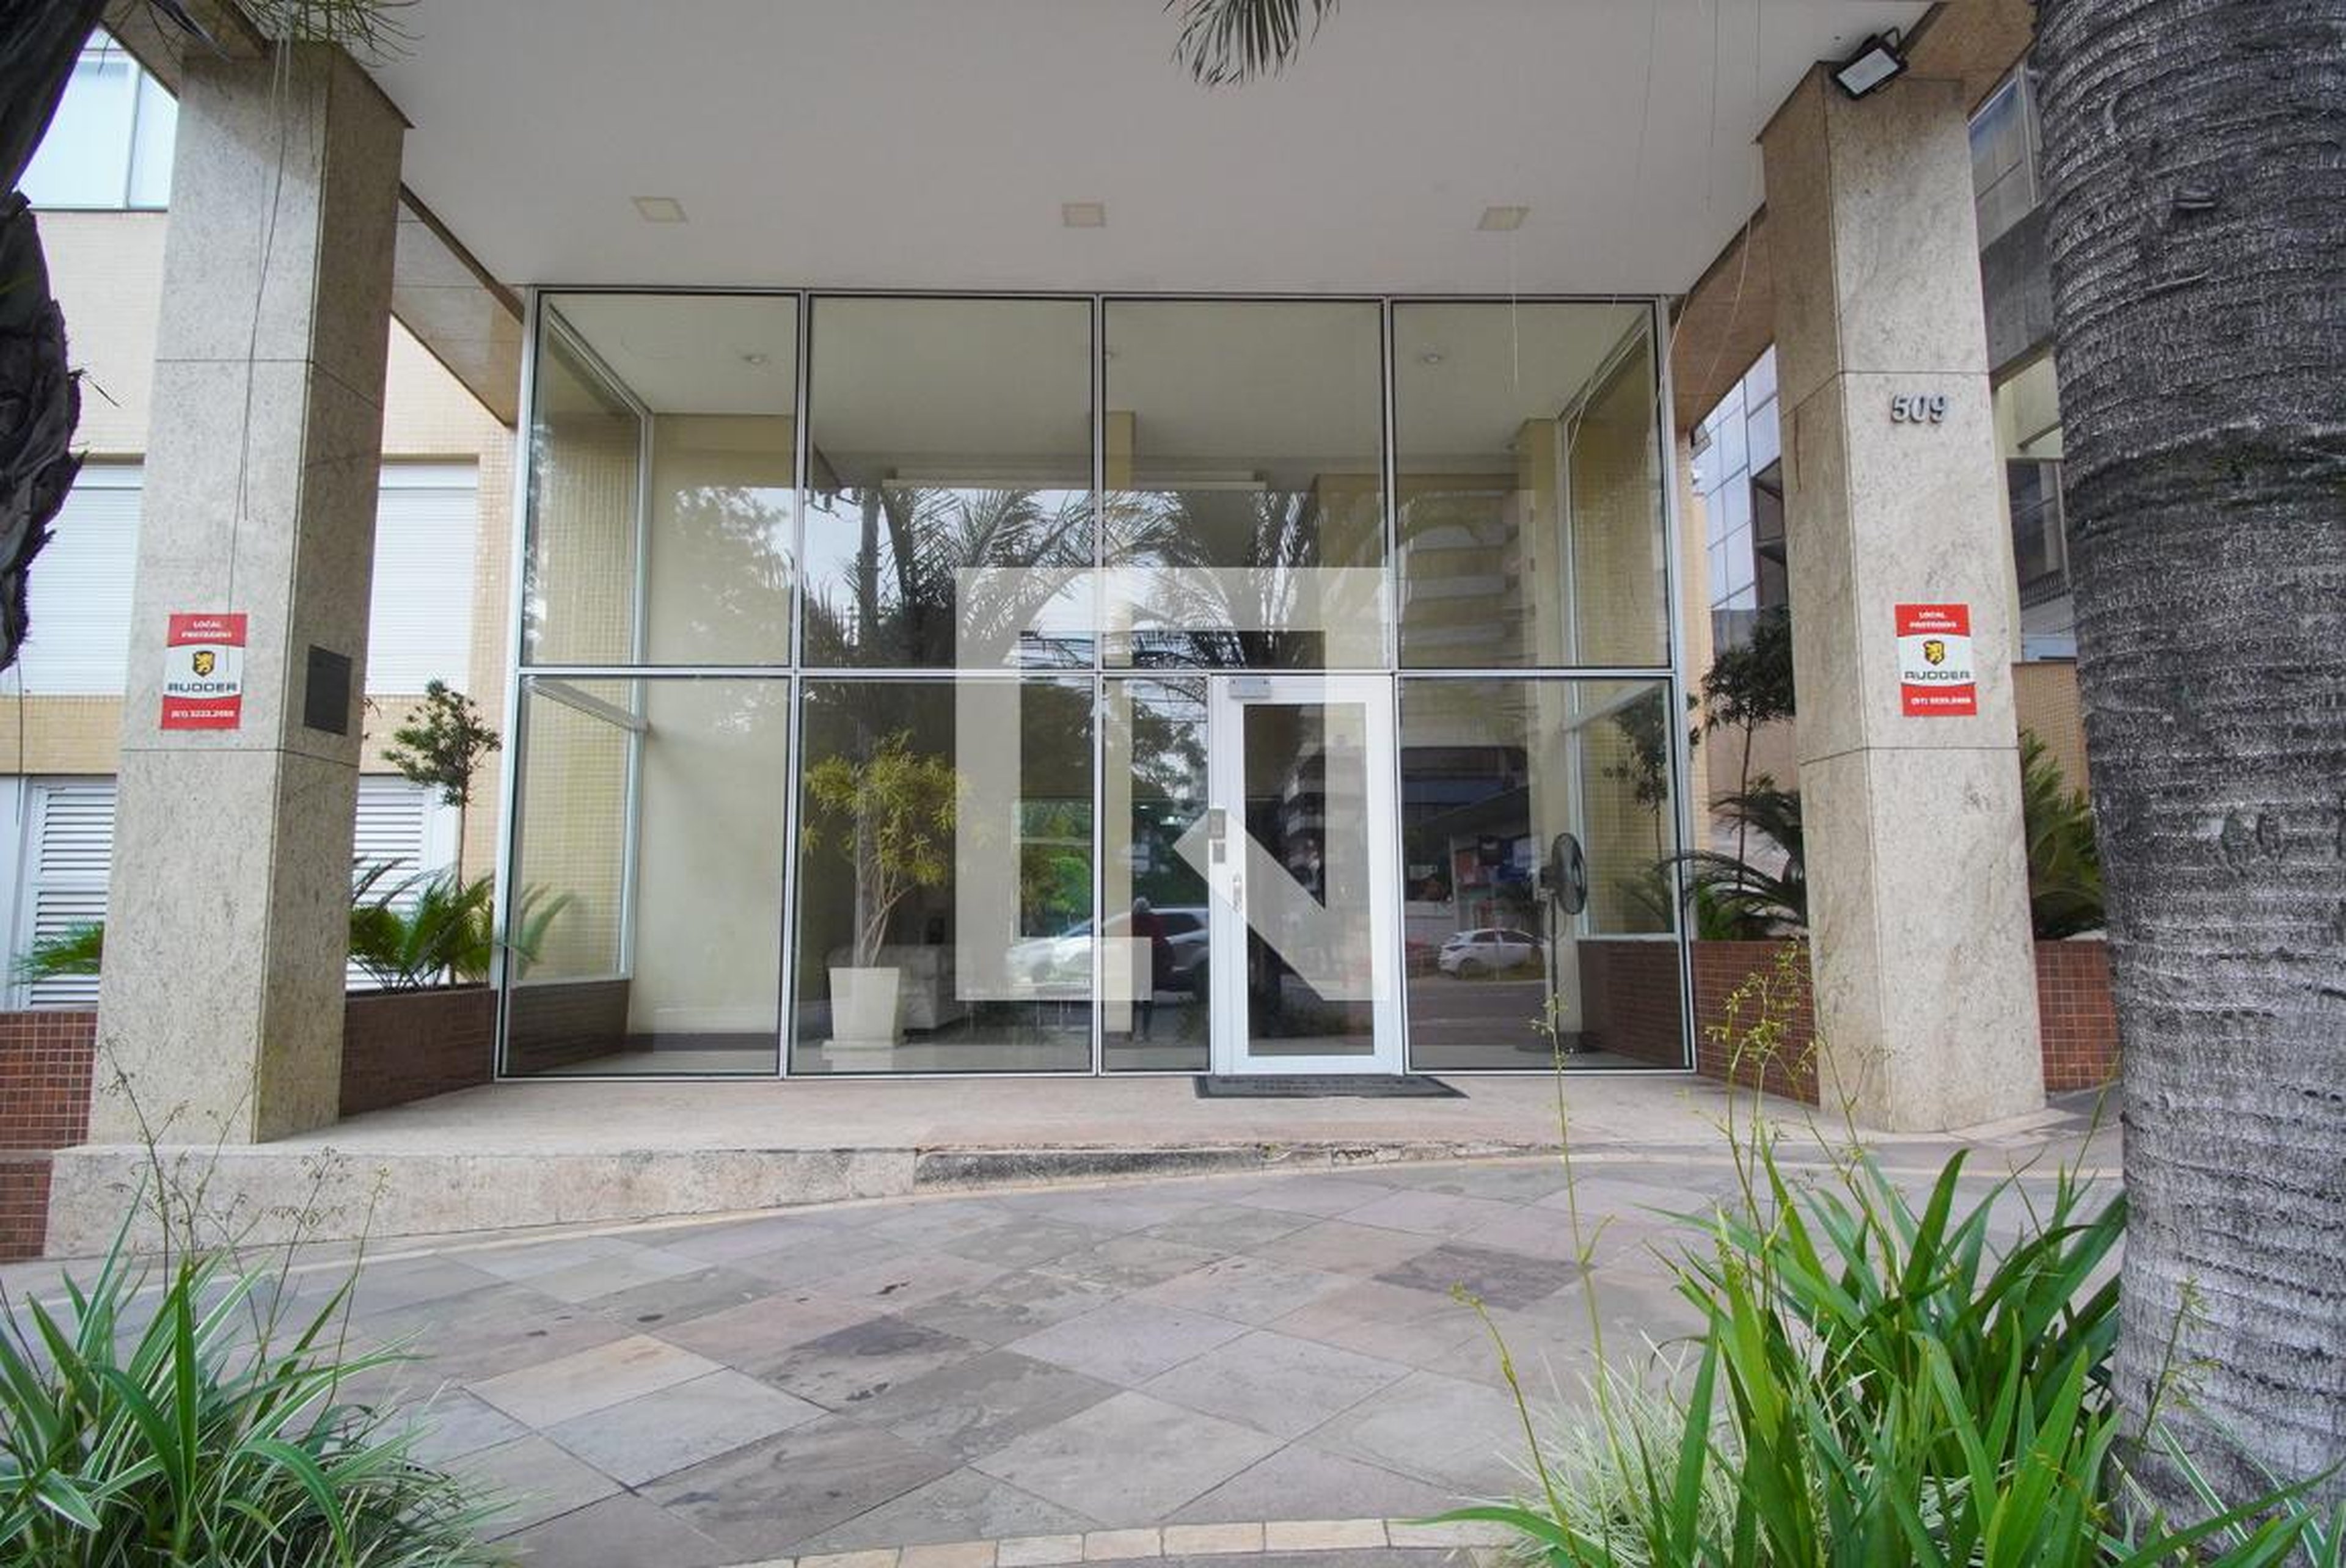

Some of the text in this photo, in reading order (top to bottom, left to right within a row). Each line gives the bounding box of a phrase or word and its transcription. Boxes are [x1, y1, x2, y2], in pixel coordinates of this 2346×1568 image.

[1890, 393, 1945, 424] 509
[192, 620, 222, 629] LOCAL
[1904, 671, 1970, 680] RUDDER
[168, 682, 238, 693] RUDDER
